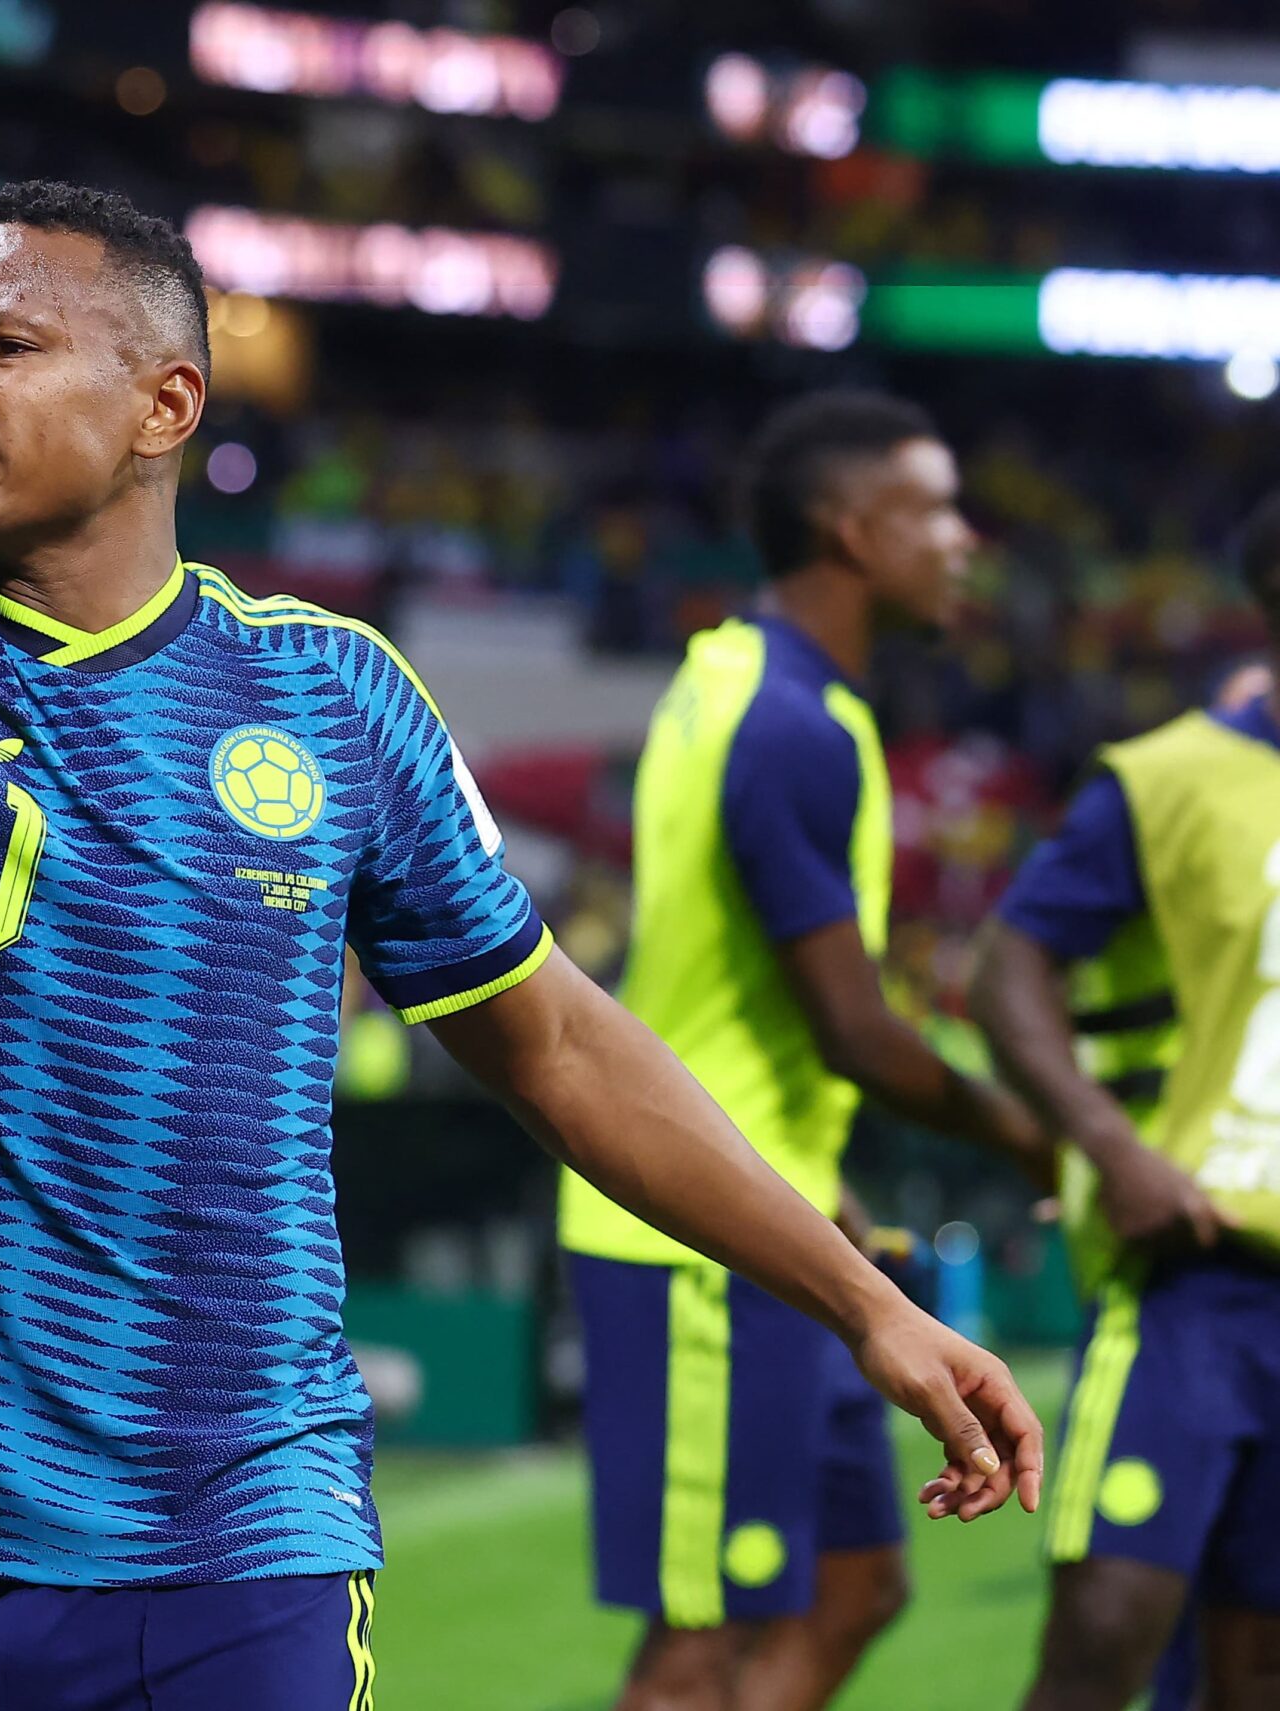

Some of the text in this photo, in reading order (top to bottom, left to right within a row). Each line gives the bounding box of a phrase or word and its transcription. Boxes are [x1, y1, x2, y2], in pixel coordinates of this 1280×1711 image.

[214, 736, 237, 780] FEDERACIÓN
[235, 727, 289, 745] COLOMBIANA
[289, 740, 301, 752] DE
[235, 867, 283, 883] UZBEKISTAN
[285, 873, 295, 885] VS
[260, 883, 310, 900] 17 JUNE 2026
[263, 895, 307, 912] MEXICO CITY
